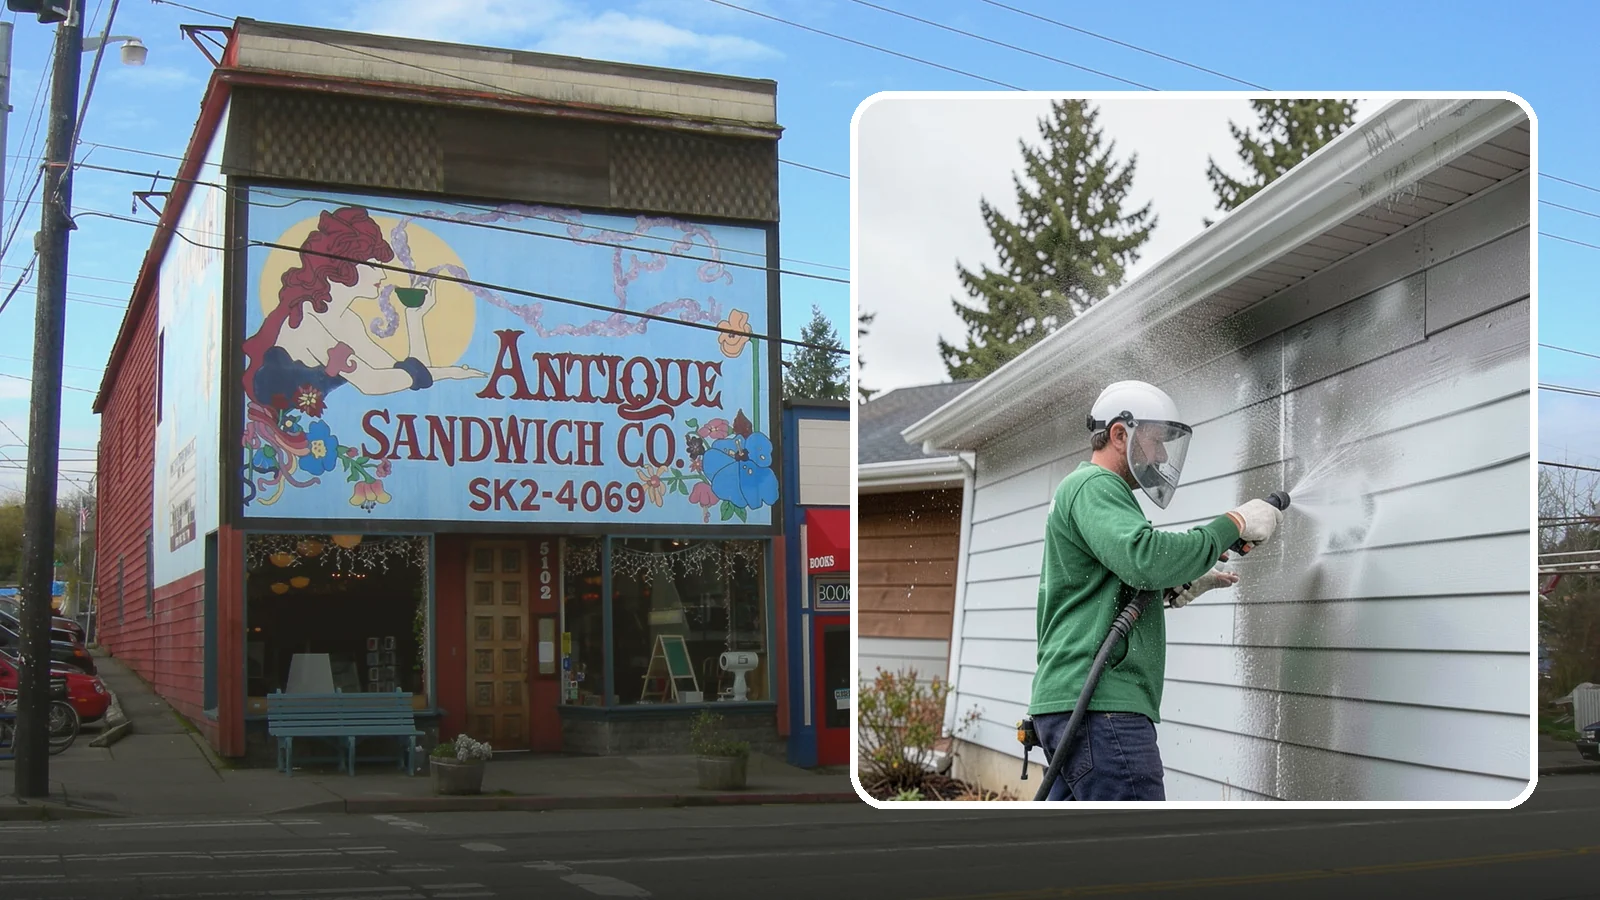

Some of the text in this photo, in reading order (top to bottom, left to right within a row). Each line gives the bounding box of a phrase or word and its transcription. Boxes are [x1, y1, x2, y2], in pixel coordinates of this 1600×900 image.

[475, 329, 724, 421] ANTIQUE
[361, 408, 685, 468] SANDWICH CO.
[468, 477, 646, 513] SK2-4069
[540, 542, 551, 600] 5102
[809, 555, 835, 569] BOOKS
